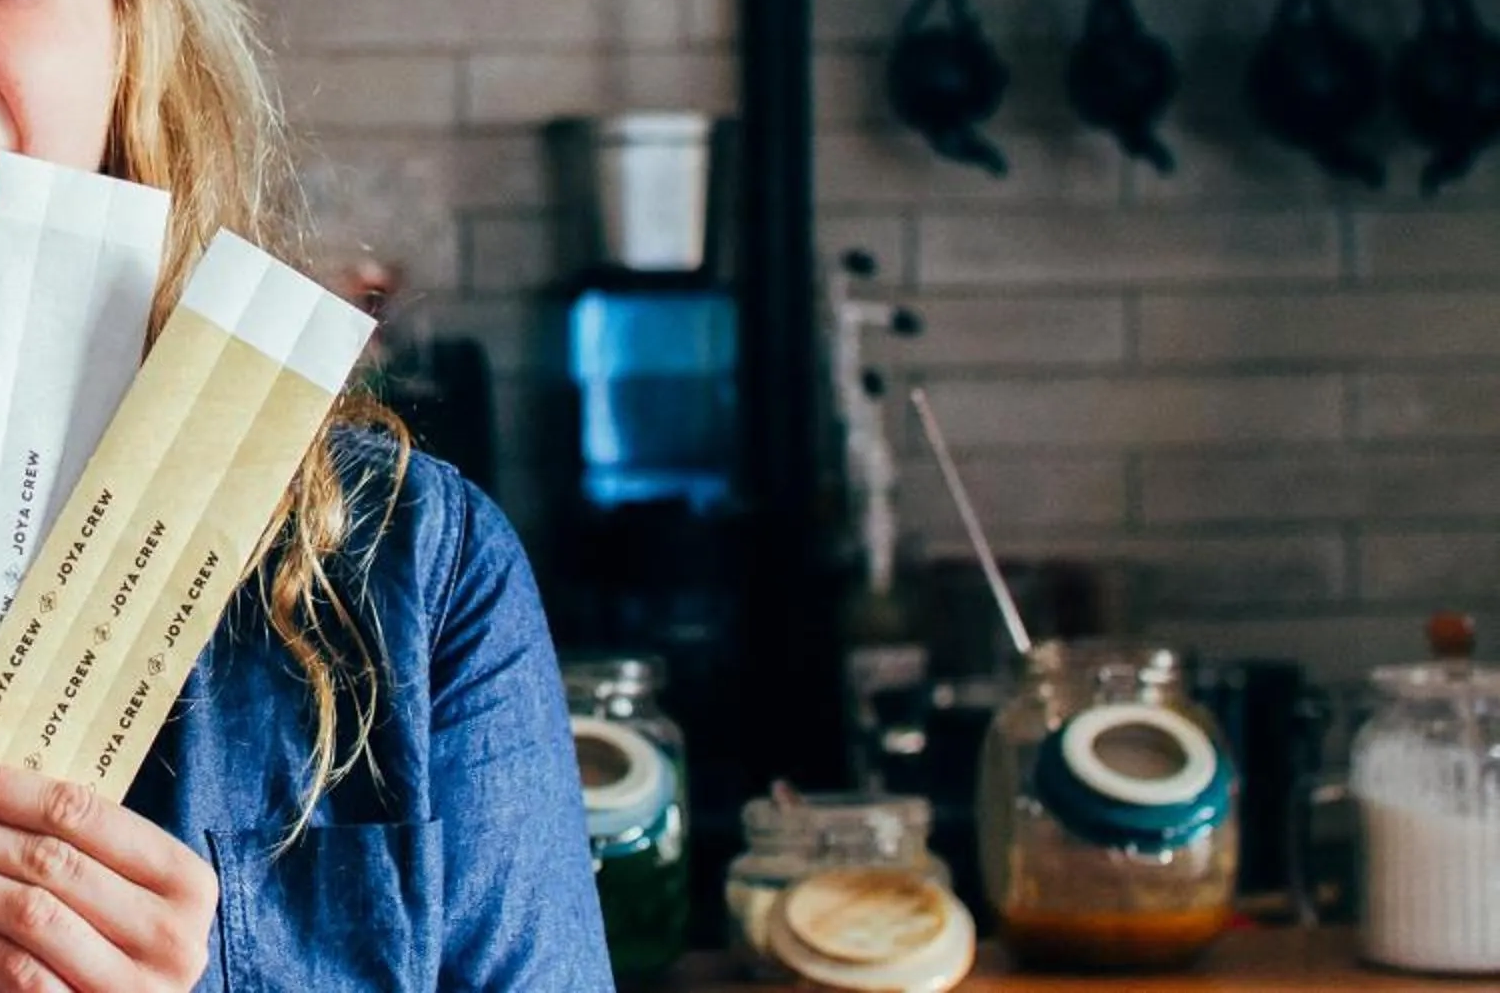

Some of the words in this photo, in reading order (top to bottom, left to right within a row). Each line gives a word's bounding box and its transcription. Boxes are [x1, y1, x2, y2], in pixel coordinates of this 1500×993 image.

[21, 450, 40, 502] CREW
[12, 508, 31, 556] JOYA
[56, 540, 85, 587] JOYA
[81, 488, 113, 539] CREW
[110, 572, 139, 617] JOYA
[135, 520, 167, 570] CREW
[11, 618, 43, 669] CREW
[163, 602, 193, 648] JOYA
[188, 551, 220, 601] CREW
[40, 701, 69, 748] JOYA
[65, 649, 97, 699] CREW
[95, 732, 125, 778] JOYA
[119, 679, 151, 730] CREW
